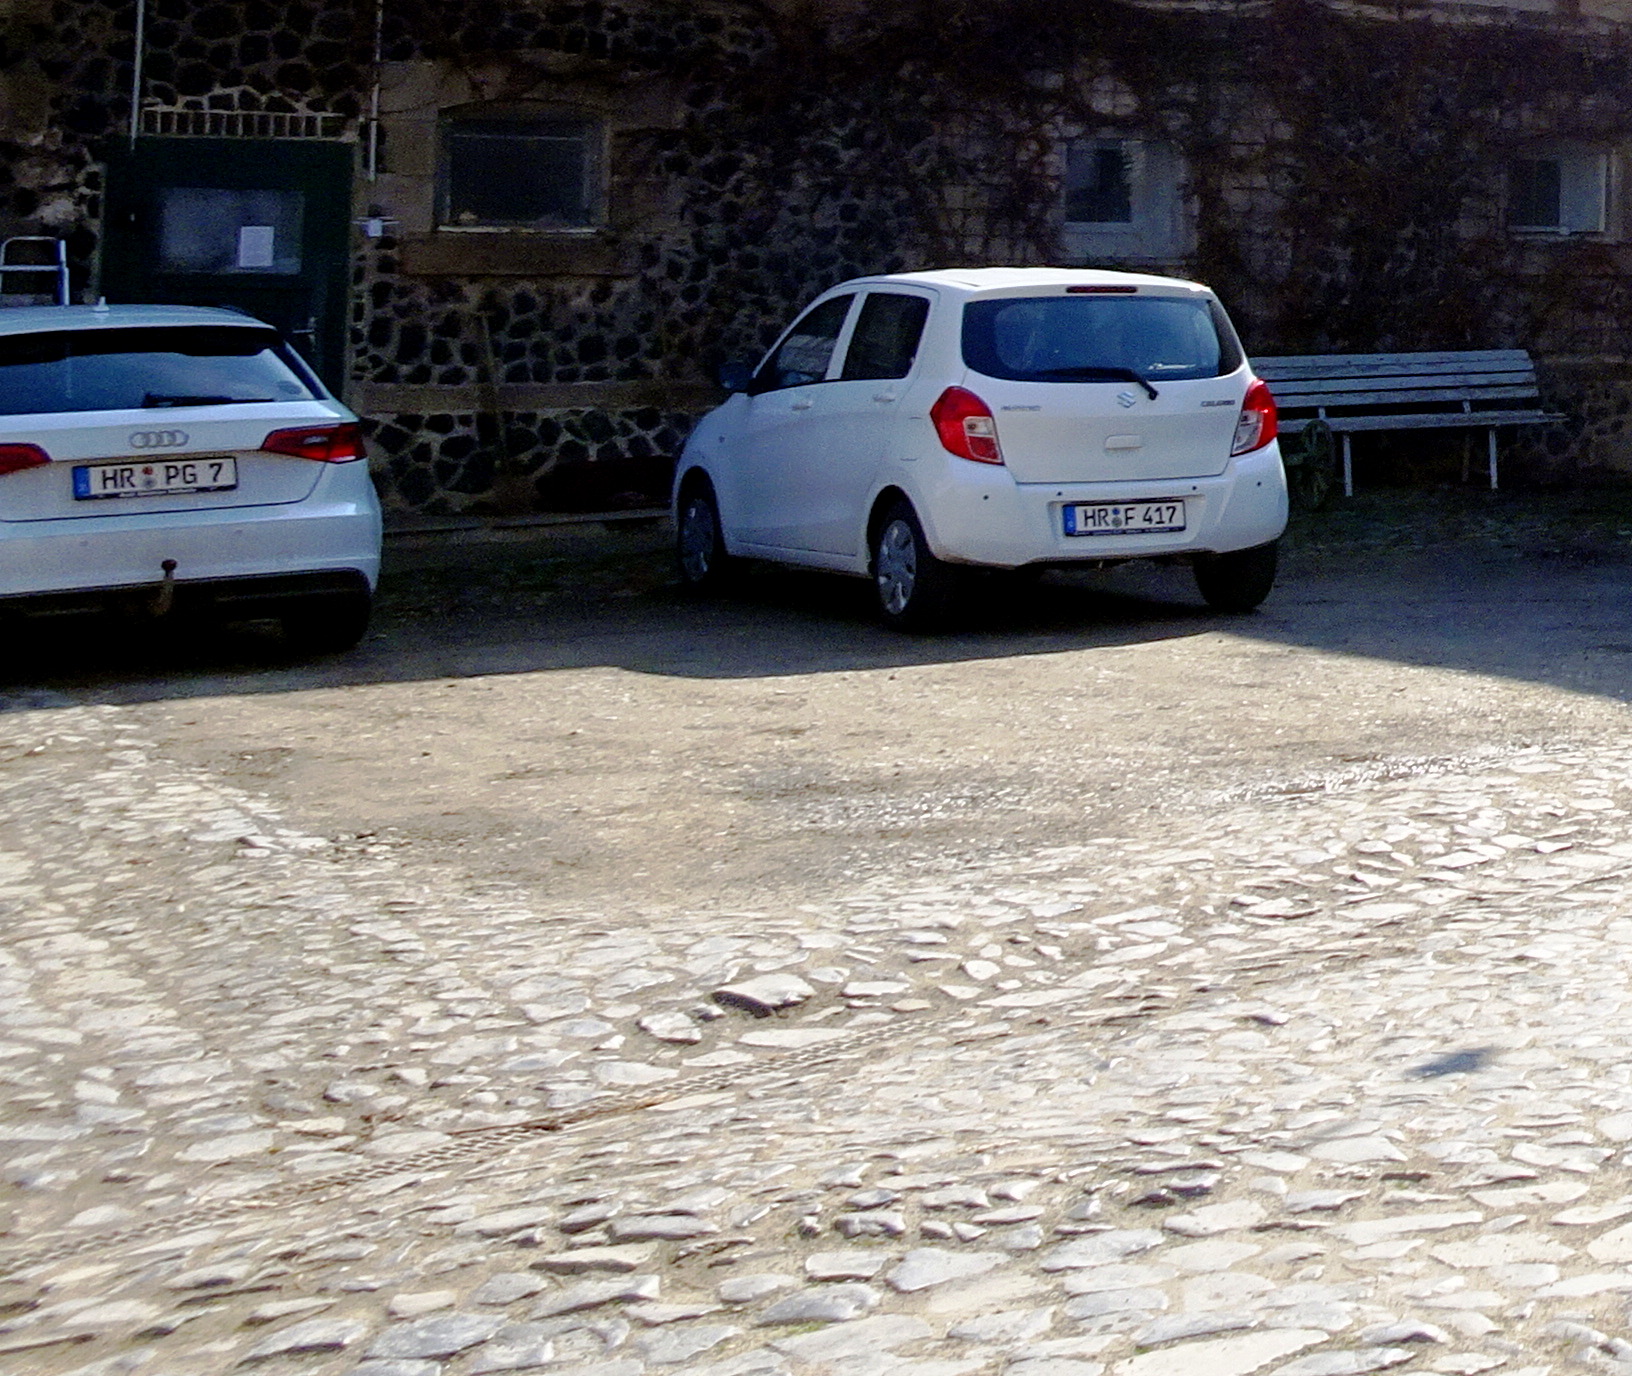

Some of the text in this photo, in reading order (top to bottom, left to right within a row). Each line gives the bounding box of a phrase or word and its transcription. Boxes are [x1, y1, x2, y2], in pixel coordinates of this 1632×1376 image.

[102, 462, 223, 490] HR PG 7
[1084, 506, 1177, 527] HR F 417
